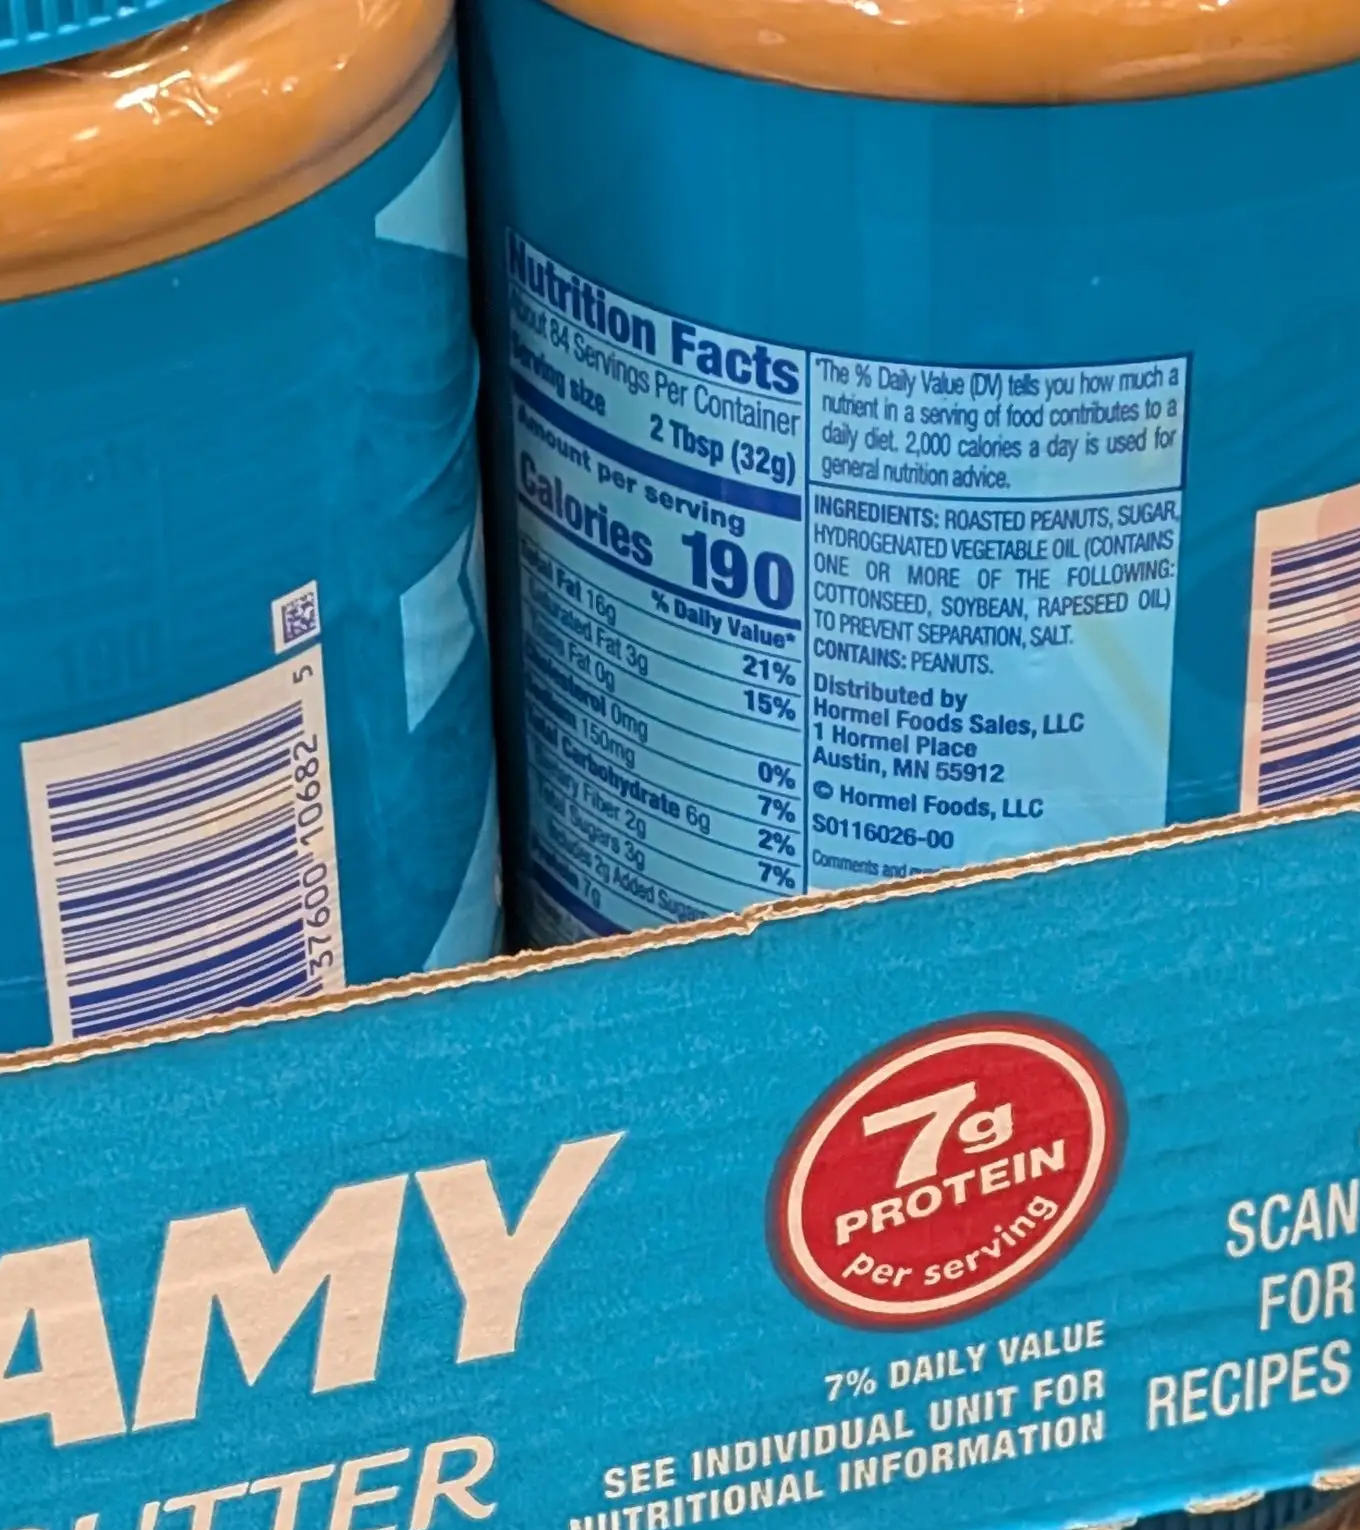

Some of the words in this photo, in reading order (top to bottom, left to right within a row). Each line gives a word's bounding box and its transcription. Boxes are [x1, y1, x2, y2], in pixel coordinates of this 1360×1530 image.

[507, 231, 656, 356] Nutrition
[671, 320, 800, 395] Facts
[655, 370, 685, 406] Per
[694, 383, 801, 438] Container
[650, 413, 663, 442] 2
[669, 419, 724, 467] Tbsp
[731, 439, 796, 486] (32g)
[597, 462, 637, 493] per
[644, 484, 745, 537] serving
[814, 494, 939, 530] INGREDIENTS:
[944, 510, 1025, 532] ROASTED
[1030, 506, 1113, 532] PEANUTS,
[520, 451, 654, 567] Calories
[682, 530, 795, 611] 190
[814, 523, 947, 560] HYDROGENATED
[951, 537, 1047, 561] VEGETABLE
[1052, 538, 1080, 560] OIL
[1084, 529, 1174, 560] (CONTAINS
[814, 552, 850, 577] ONE
[866, 560, 890, 583] OR
[908, 565, 960, 589] MORE
[978, 568, 1002, 590] OF
[1016, 567, 1050, 590] THE
[1067, 559, 1176, 588] FOLLOWING:
[651, 589, 670, 613] %
[674, 598, 723, 634] Daily
[813, 580, 932, 617] COTTONSEED,
[941, 596, 1028, 621] SOYBEAN,
[1038, 592, 1128, 617] RAPESEED
[1138, 587, 1171, 612] OIL)
[813, 608, 836, 632] TO
[839, 613, 915, 642] PREVENT
[918, 622, 1026, 650] SEPARATION,
[1030, 624, 1074, 647] SALT.
[743, 655, 796, 686] 21%
[813, 637, 907, 670] CONTAINS:
[911, 649, 994, 675] PEANUTS.
[743, 689, 796, 721] 15%
[814, 673, 934, 707] Distributed
[940, 688, 968, 712] by
[813, 721, 823, 740] 1
[832, 724, 910, 754] Hormel
[916, 736, 978, 758] Place
[814, 697, 890, 727] Hormel
[896, 710, 963, 734] Foods
[969, 713, 1037, 740] Sales,
[1043, 712, 1086, 735] LLC
[757, 761, 795, 790] 0%
[812, 745, 887, 779] Austin,
[893, 758, 930, 780] MN
[935, 762, 1005, 783] 55912
[294, 734, 322, 845] 10682
[757, 795, 795, 823] 7%
[840, 784, 917, 813] Hormel
[923, 795, 997, 821] Foods,
[1002, 798, 1044, 818] LLC
[758, 828, 795, 856] 2%
[812, 813, 955, 850] S0116026-00
[301, 862, 334, 978] 37600
[863, 1081, 1014, 1189] 7g
[836, 1139, 1065, 1246] PROTEIN
[1226, 1179, 1359, 1258] SCAN
[842, 1253, 913, 1287] per
[923, 1195, 1059, 1286] serving
[1260, 1261, 1355, 1331] FOR
[824, 1366, 877, 1402] 7%
[889, 1342, 987, 1390] DAILY
[999, 1319, 1106, 1367] VALUE
[1146, 1339, 1352, 1431] RECIPES
[603, 1456, 677, 1500] SEE
[692, 1409, 914, 1481] INDIVIDUAL
[929, 1385, 1018, 1432] UNIT
[1033, 1368, 1106, 1411] FOR
[839, 1410, 1106, 1493] INFORMATION
